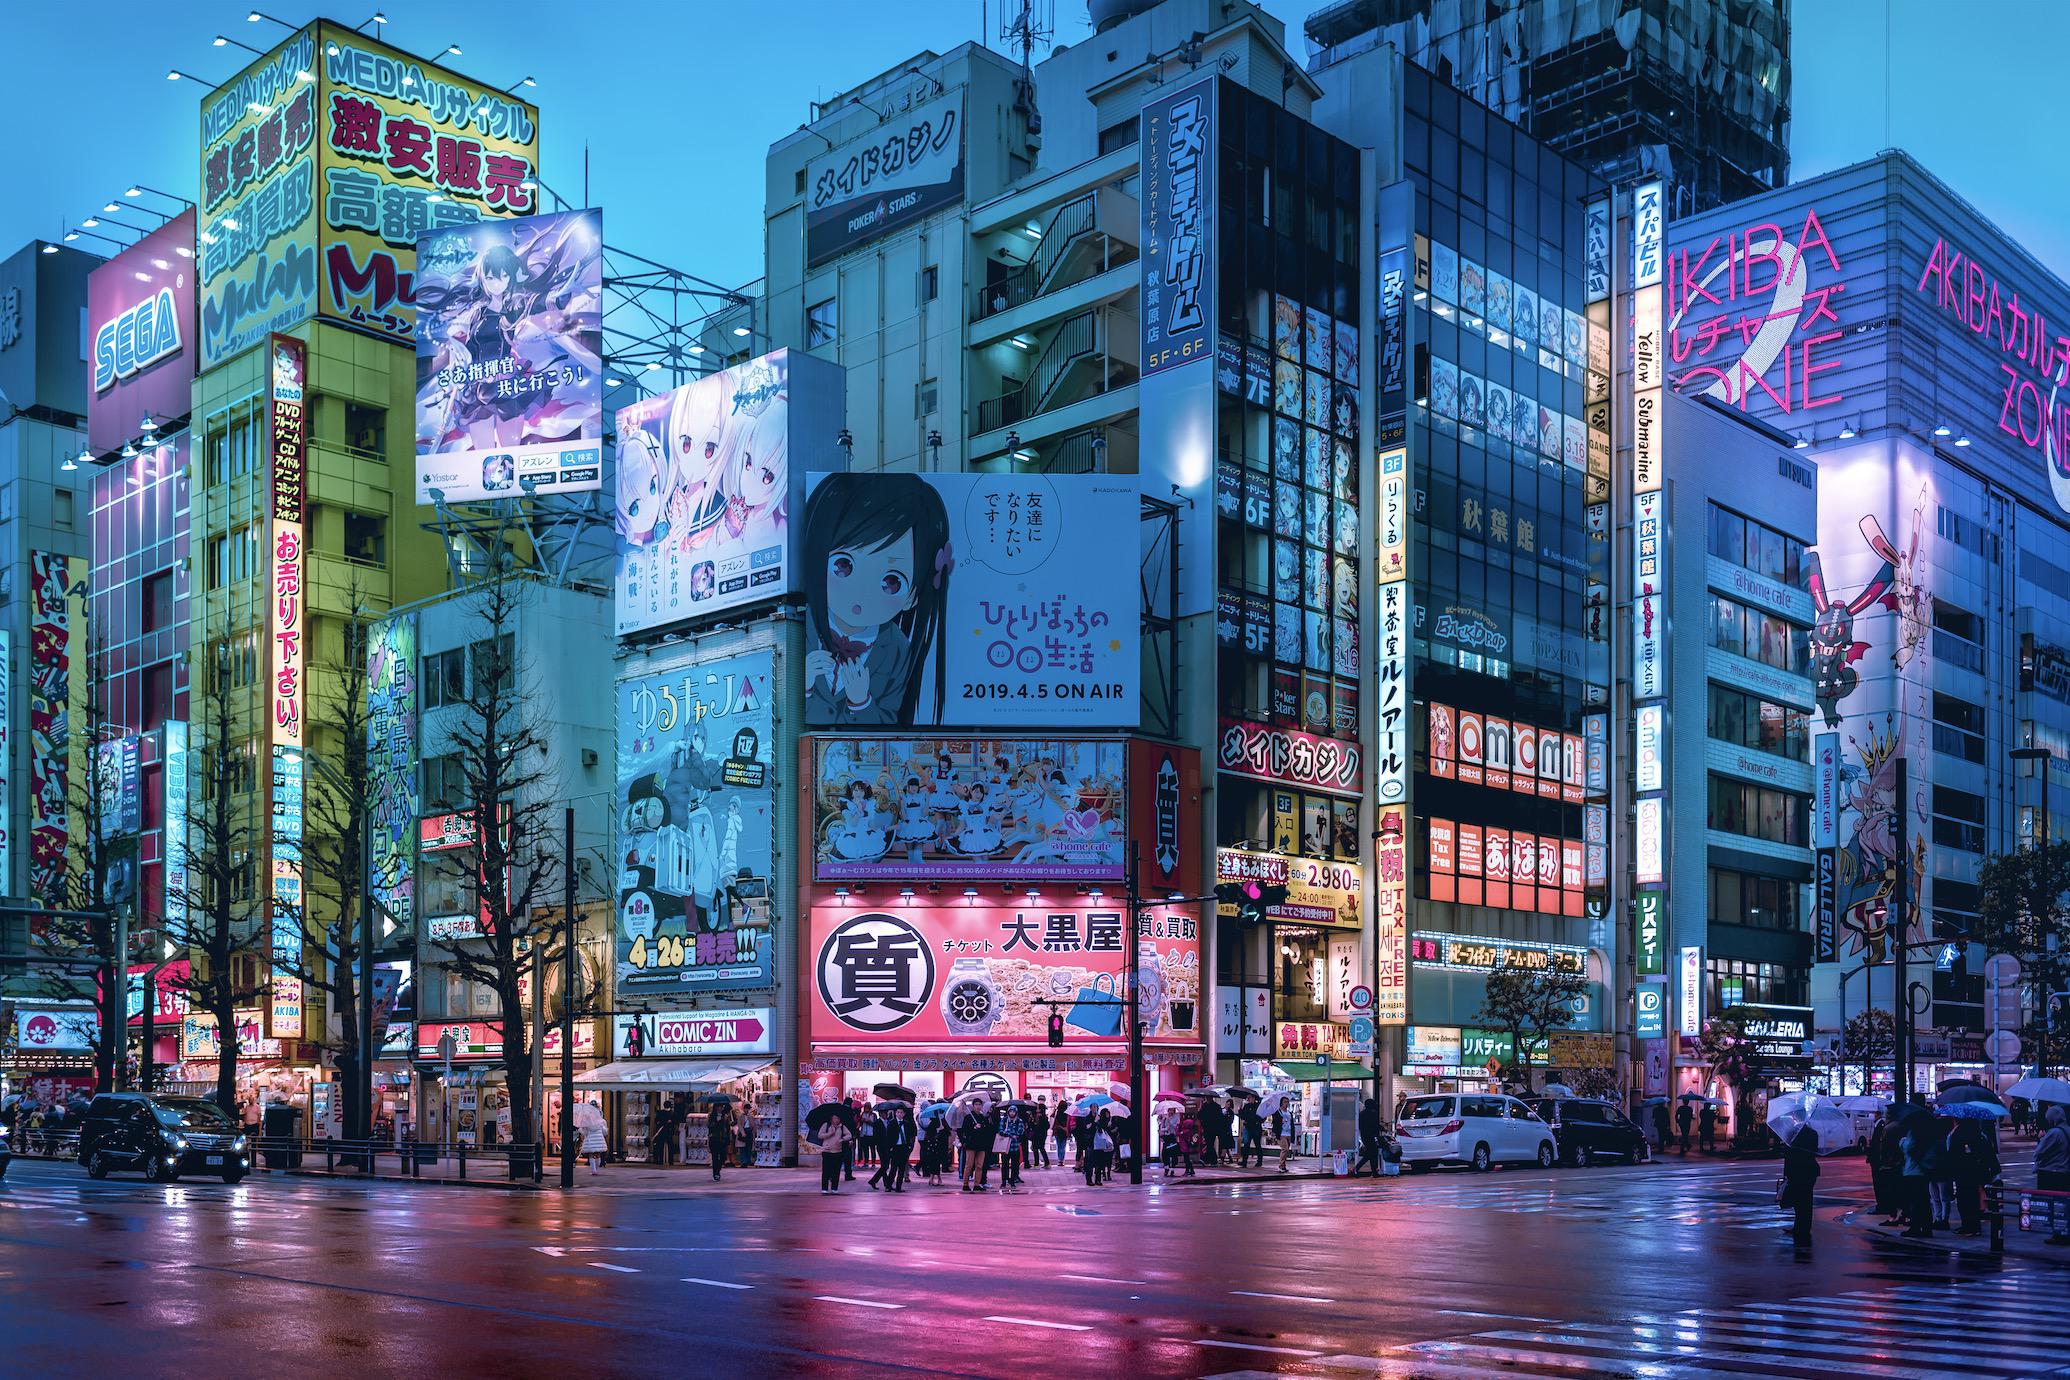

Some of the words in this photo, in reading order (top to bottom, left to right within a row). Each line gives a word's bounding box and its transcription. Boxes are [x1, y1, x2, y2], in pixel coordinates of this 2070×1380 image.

[326, 42, 533, 143] MEDIAリサイクル
[204, 85, 313, 211] 激安販売
[330, 94, 532, 210] 激安販売
[815, 110, 955, 208] メイドカジノ
[848, 212, 875, 233] POKER
[1640, 191, 1659, 278] スーパービル
[203, 242, 315, 358] Mulan
[1147, 270, 1160, 344] 秋葉原店
[350, 305, 414, 331] ムーラン
[94, 287, 182, 392] SEGA
[1638, 332, 1653, 383] Yellow
[438, 356, 523, 387] さあ指揮官、
[275, 387, 301, 399] あなたの
[497, 368, 583, 398] 共に行こう!
[1246, 374, 1270, 404] 7F
[276, 402, 300, 418] DVD
[275, 416, 301, 431] ブルーレイ
[275, 428, 300, 444] ゲーム
[1566, 436, 1586, 458] 3.16
[1638, 398, 1653, 483] Submarine
[279, 443, 296, 456] CD
[577, 452, 594, 463] 検索
[275, 455, 300, 469] アイドル
[522, 456, 553, 467] アズレン
[1386, 458, 1401, 471] 3F
[275, 468, 300, 482] アニメ
[431, 474, 458, 483] Yostar
[276, 482, 299, 496] コミック
[276, 495, 299, 507] ホビー
[1641, 495, 1656, 506] 5F
[275, 508, 299, 521] フィギュア
[1027, 492, 1043, 542] 友達に
[1246, 498, 1270, 526] 6F
[1388, 482, 1397, 544] りらくる
[1006, 493, 1022, 557] なりたい
[1463, 498, 1534, 552] 秋葉館
[1640, 518, 1656, 576] 秋葉館
[670, 540, 679, 608] これが君の
[720, 560, 745, 573] アズレン
[1734, 570, 1770, 602] @home
[1771, 588, 1792, 609] cafe
[980, 594, 1109, 640] ひとりぼっちの
[1246, 624, 1270, 651] 5F
[962, 684, 1047, 700] 2019.4.5
[1055, 684, 1087, 700] ON
[1090, 684, 1124, 700] AIR
[1275, 701, 1297, 717] Stars
[273, 746, 284, 756] 6F
[391, 656, 410, 826] 日本最大級
[1460, 715, 1575, 783] amiami
[1643, 711, 1655, 787] amiami
[1221, 725, 1360, 788] メイドカジノ
[1737, 756, 1763, 774] @home
[1764, 762, 1778, 779] cafe
[170, 752, 184, 798] SEGA
[276, 764, 299, 773] DVD
[273, 775, 284, 785] 5F
[1822, 768, 1834, 814] @home
[273, 804, 284, 814] 4F
[1278, 799, 1291, 811] 3F
[275, 821, 300, 831] DVD
[1274, 816, 1294, 830] 入口
[1823, 815, 1832, 834] cafe
[273, 832, 284, 841] 3F
[1051, 842, 1089, 851] @home
[1091, 842, 1112, 851] cafe
[1381, 812, 1404, 882] 免税
[1433, 841, 1449, 853] Tax
[1221, 856, 1288, 881] 全身もみほぐし
[1431, 854, 1450, 867] Free
[1487, 836, 1557, 882] あみあみ
[1394, 889, 1404, 928] TAX
[1820, 853, 1833, 958] GALLERIA
[274, 935, 300, 946] DVD
[943, 939, 994, 954] チケット
[1001, 913, 1122, 953] 大黒屋
[1381, 889, 1392, 987] 면세점
[1642, 897, 1657, 968] リバティー
[1394, 936, 1404, 986] FREE
[833, 933, 921, 1017] 質
[1340, 956, 1351, 1011] ルノアール
[1354, 991, 1367, 1003] 40
[274, 1006, 299, 1016] AKIBA
[659, 1012, 681, 1020] Professional
[1688, 1012, 1697, 1032] cafe
[660, 1022, 711, 1043] COMIC
[714, 1021, 737, 1042] ZIN
[1282, 1024, 1318, 1050] 免税
[1322, 1026, 1336, 1043] TAX
[1355, 1024, 1364, 1039] P
[1745, 1020, 1804, 1038] GALLERIA
[659, 1045, 702, 1053] Akihabara
[1463, 1038, 1511, 1055] リバティー
[815, 1058, 858, 1069] 高価買取
[1082, 1058, 1125, 1069] 無料査定
